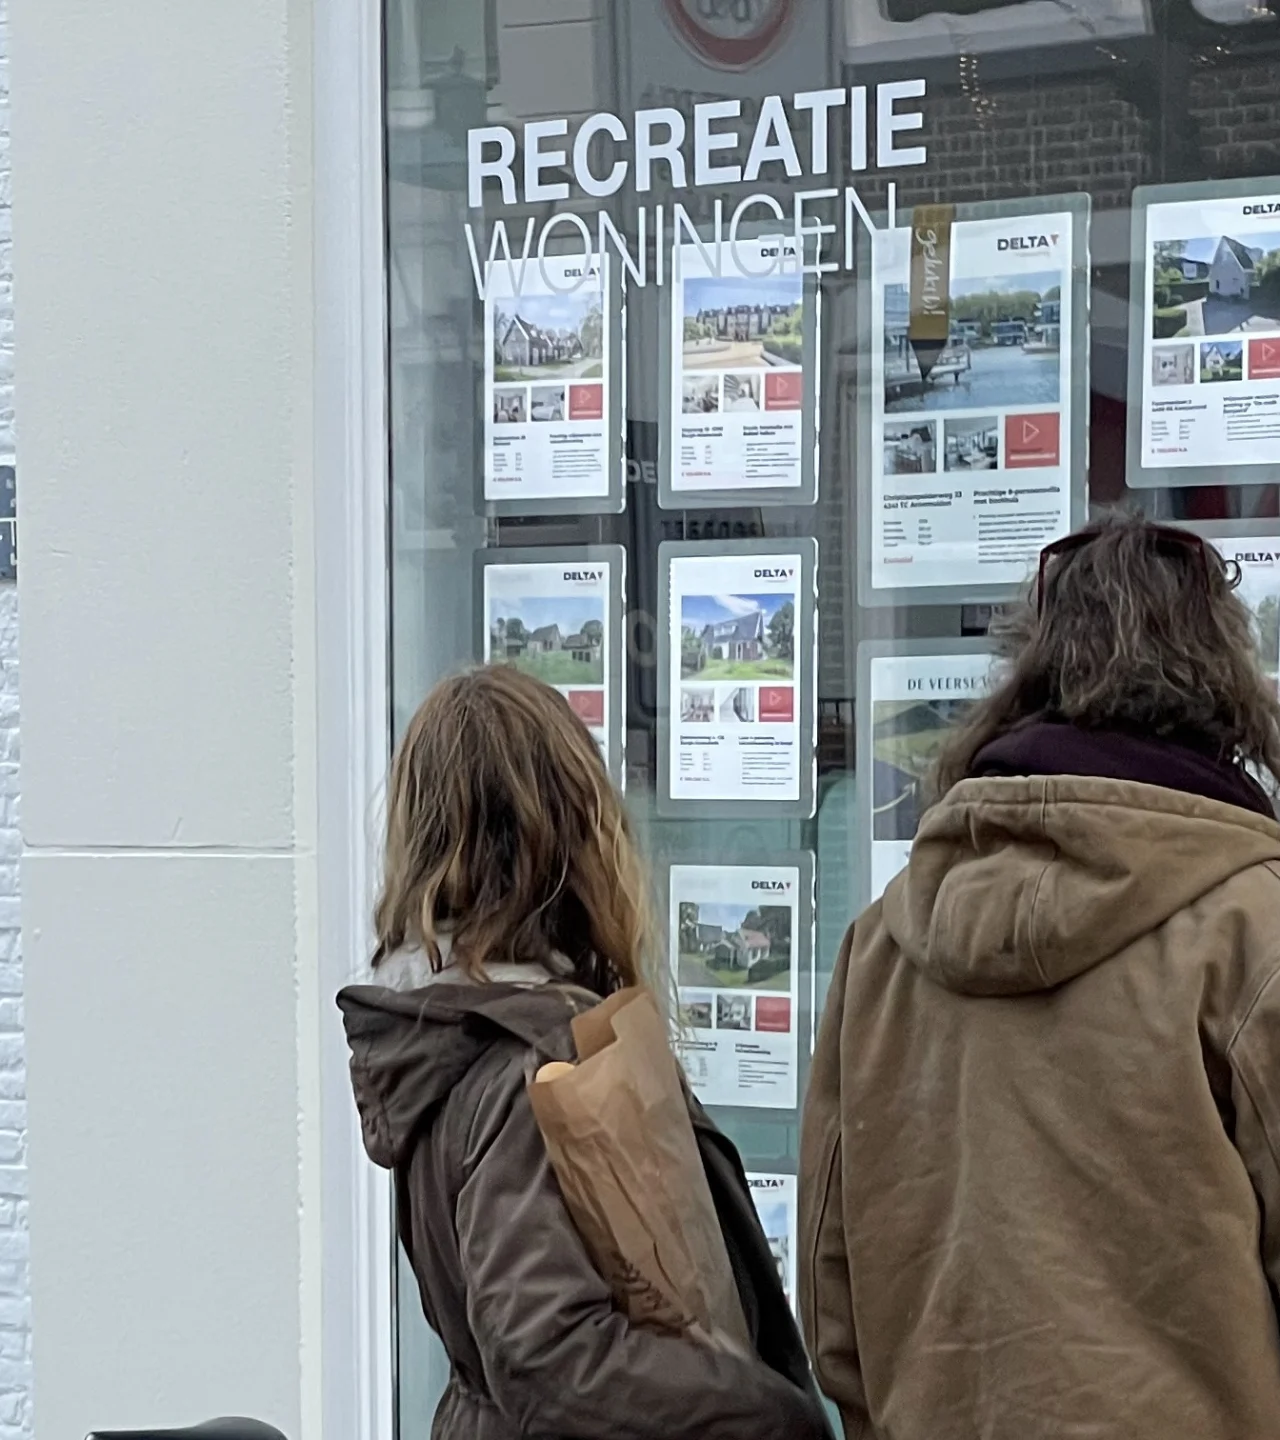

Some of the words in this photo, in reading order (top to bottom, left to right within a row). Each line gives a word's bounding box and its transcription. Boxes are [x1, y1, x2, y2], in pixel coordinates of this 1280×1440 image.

[467, 79, 926, 208] RECREATIE
[464, 183, 897, 301] WONINGEN
[997, 235, 1049, 251] DELTA
[1235, 552, 1273, 562] DELTA
[564, 571, 596, 581] DELTA
[754, 569, 787, 578] DELTA
[908, 678, 924, 690] DE
[751, 881, 784, 890] DELTA
